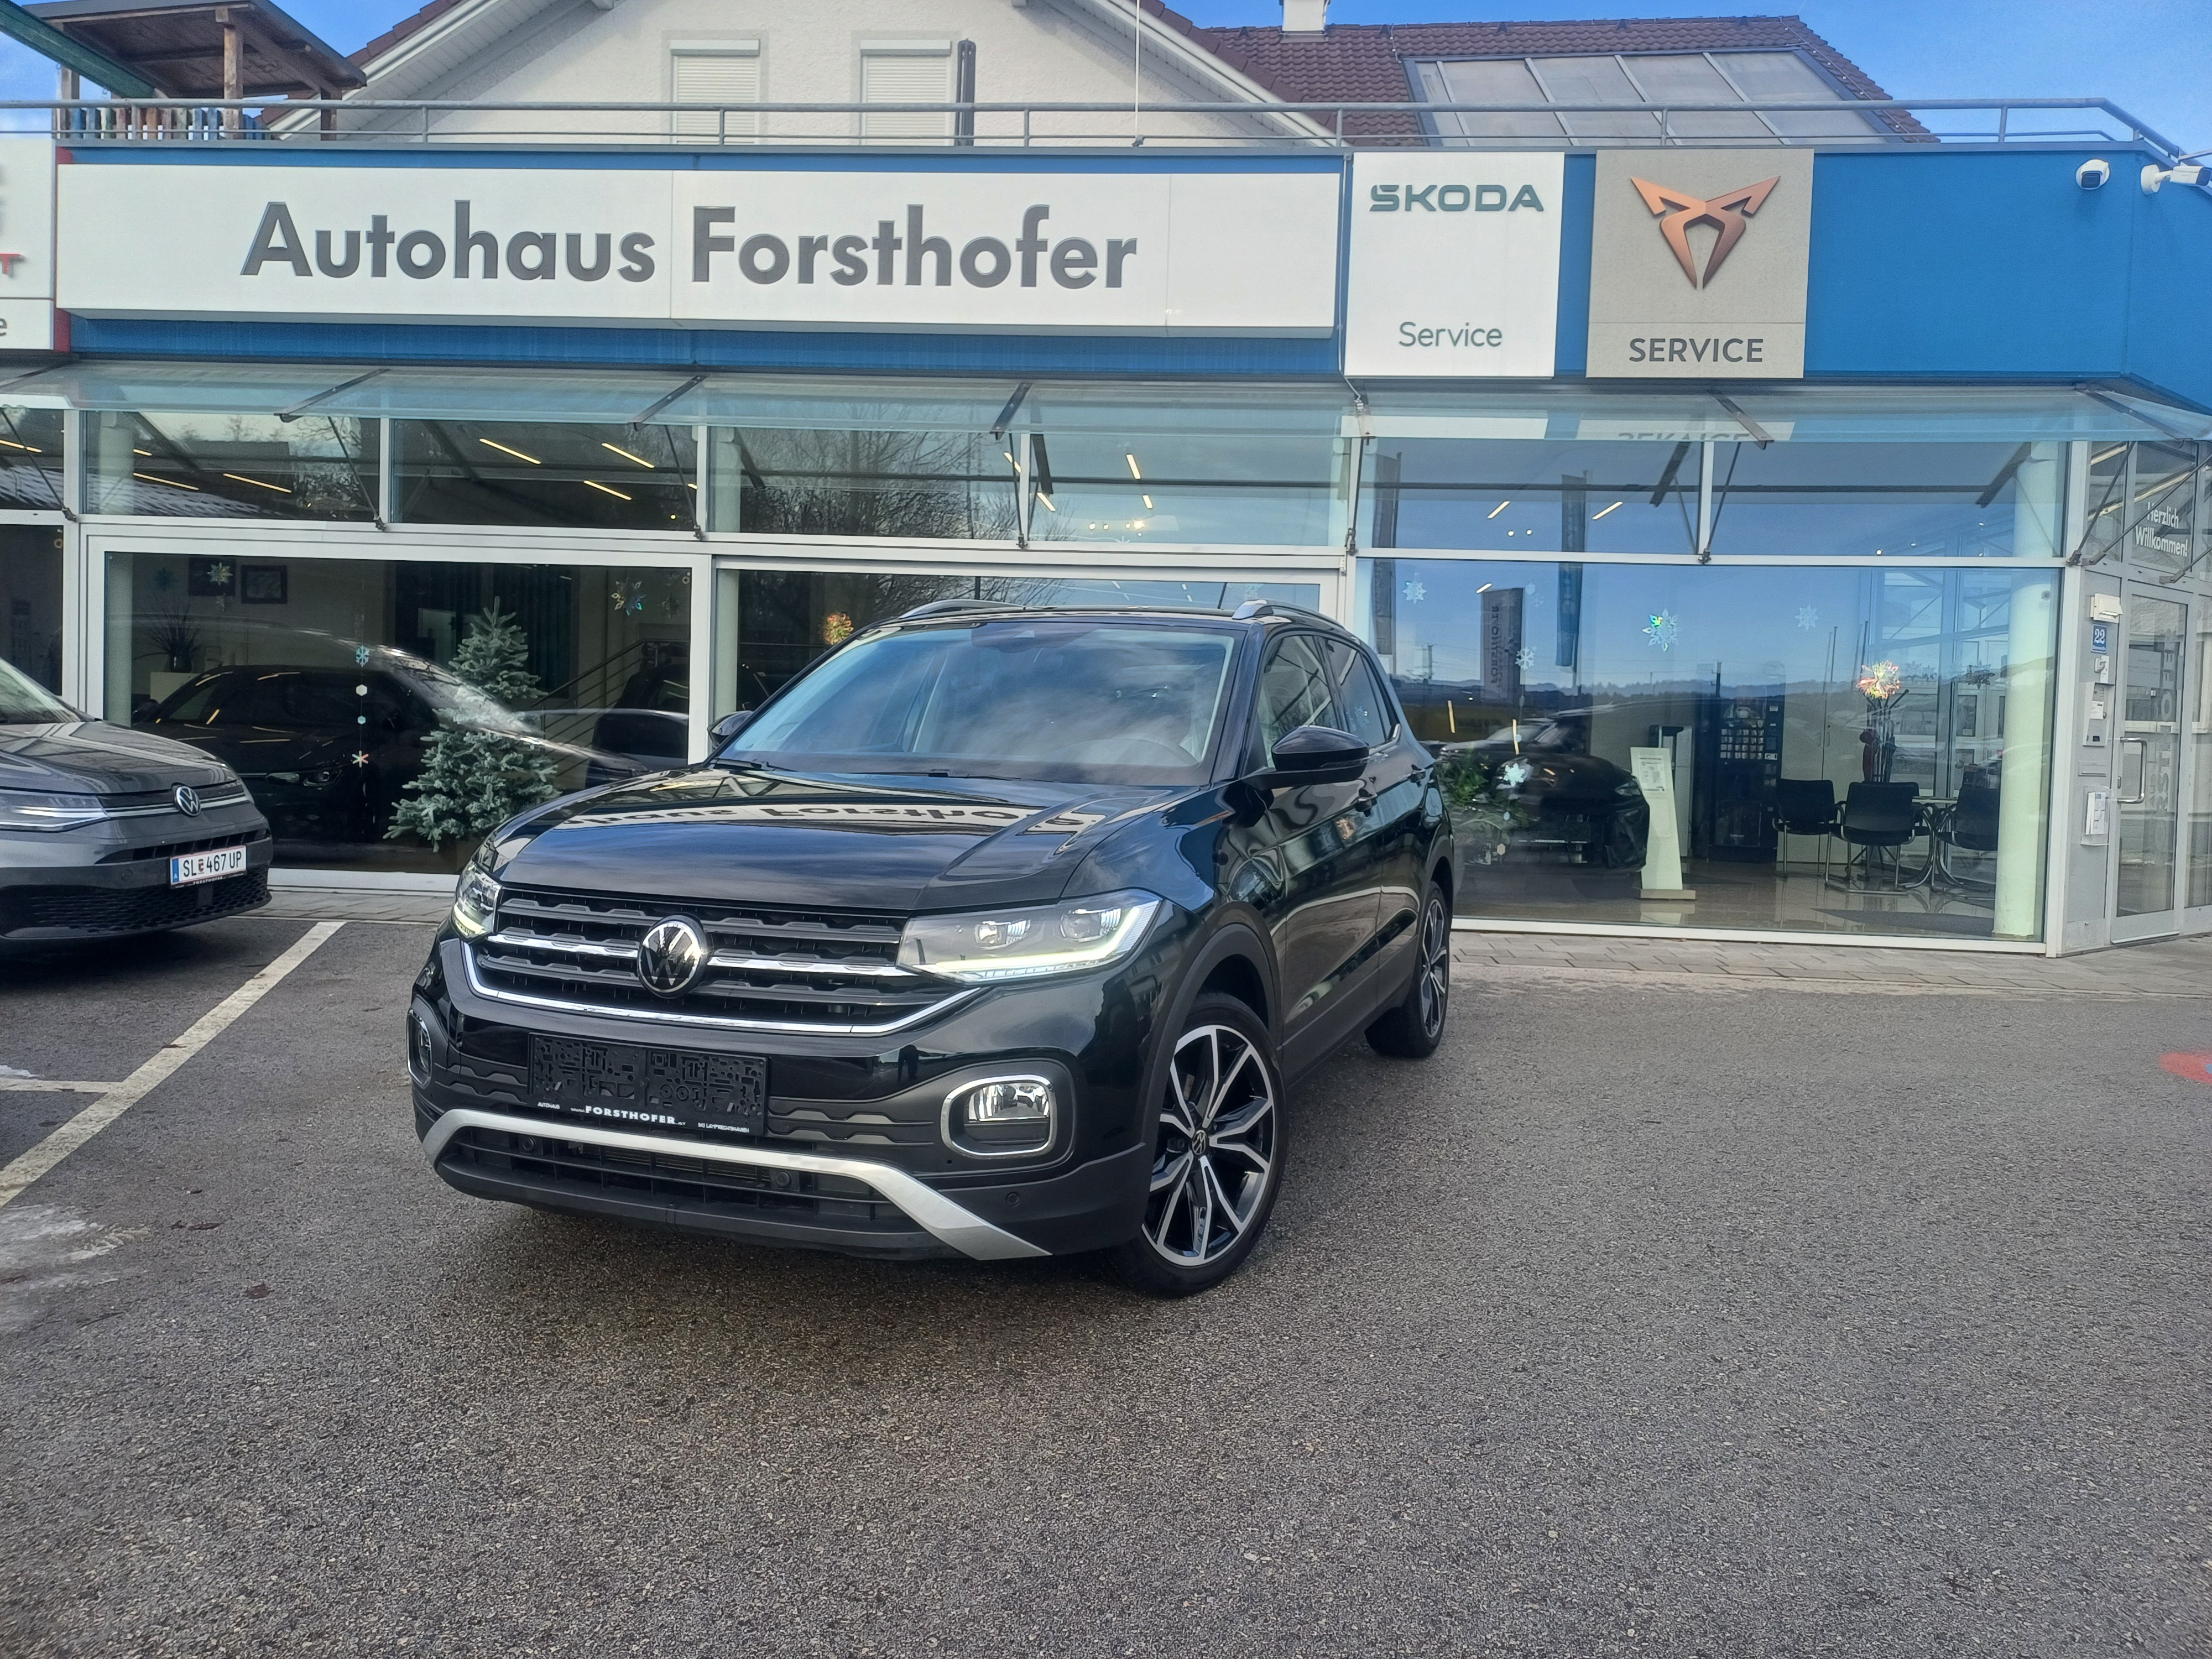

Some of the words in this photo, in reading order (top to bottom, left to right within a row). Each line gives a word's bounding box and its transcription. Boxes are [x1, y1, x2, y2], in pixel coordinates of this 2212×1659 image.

[240, 200, 655, 282] Autohaus
[693, 205, 1137, 289] Forsthofer
[1399, 321, 1502, 347] Service
[1629, 338, 1764, 362] SERVICE
[2147, 502, 2179, 529] Herzlich
[2135, 525, 2188, 557] Willkommen!
[2094, 628, 2105, 644] 22
[183, 859, 197, 877] SL
[206, 853, 226, 873] 467
[229, 851, 242, 869] UP
